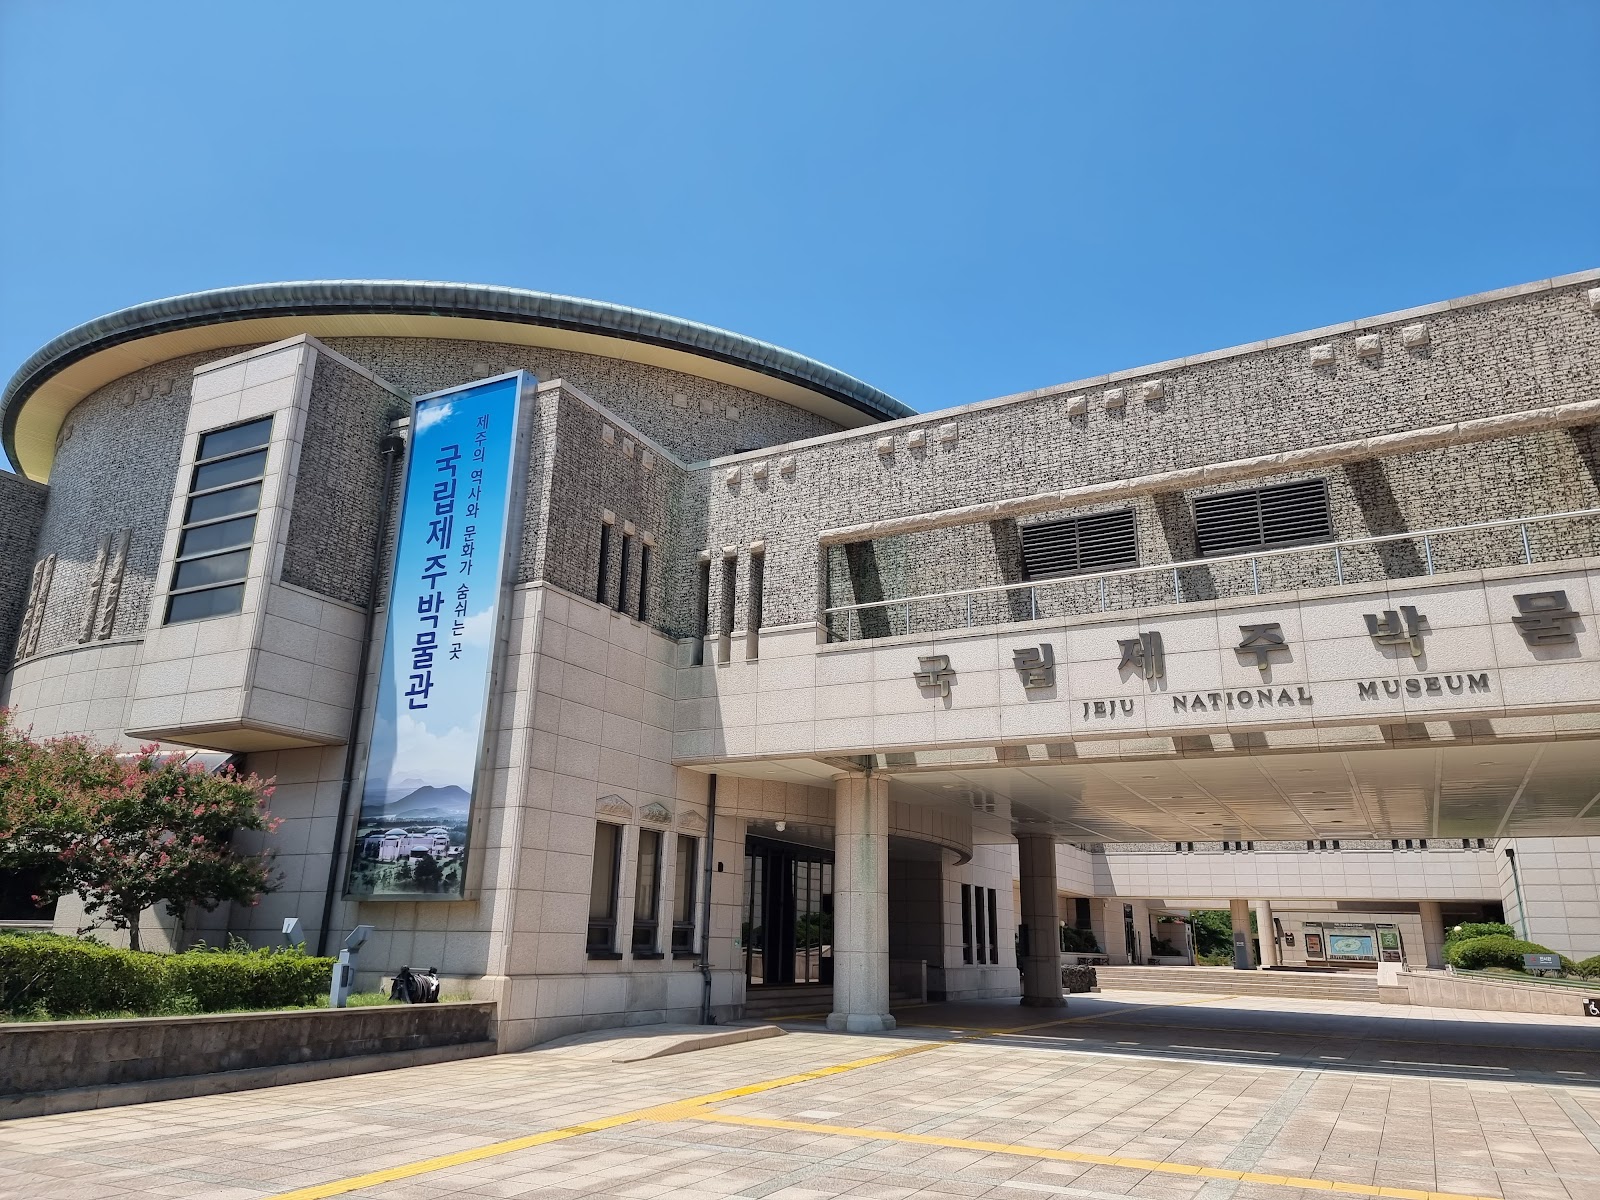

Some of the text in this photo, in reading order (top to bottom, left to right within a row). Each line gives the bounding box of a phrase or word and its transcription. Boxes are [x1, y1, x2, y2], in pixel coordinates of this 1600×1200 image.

[404, 443, 462, 710] 국립제주박물관
[449, 413, 490, 661] 제주의 역사와 문화가 숨쉬는 곳
[1083, 673, 1490, 718] JEJU NATIONAL MUSEUM
